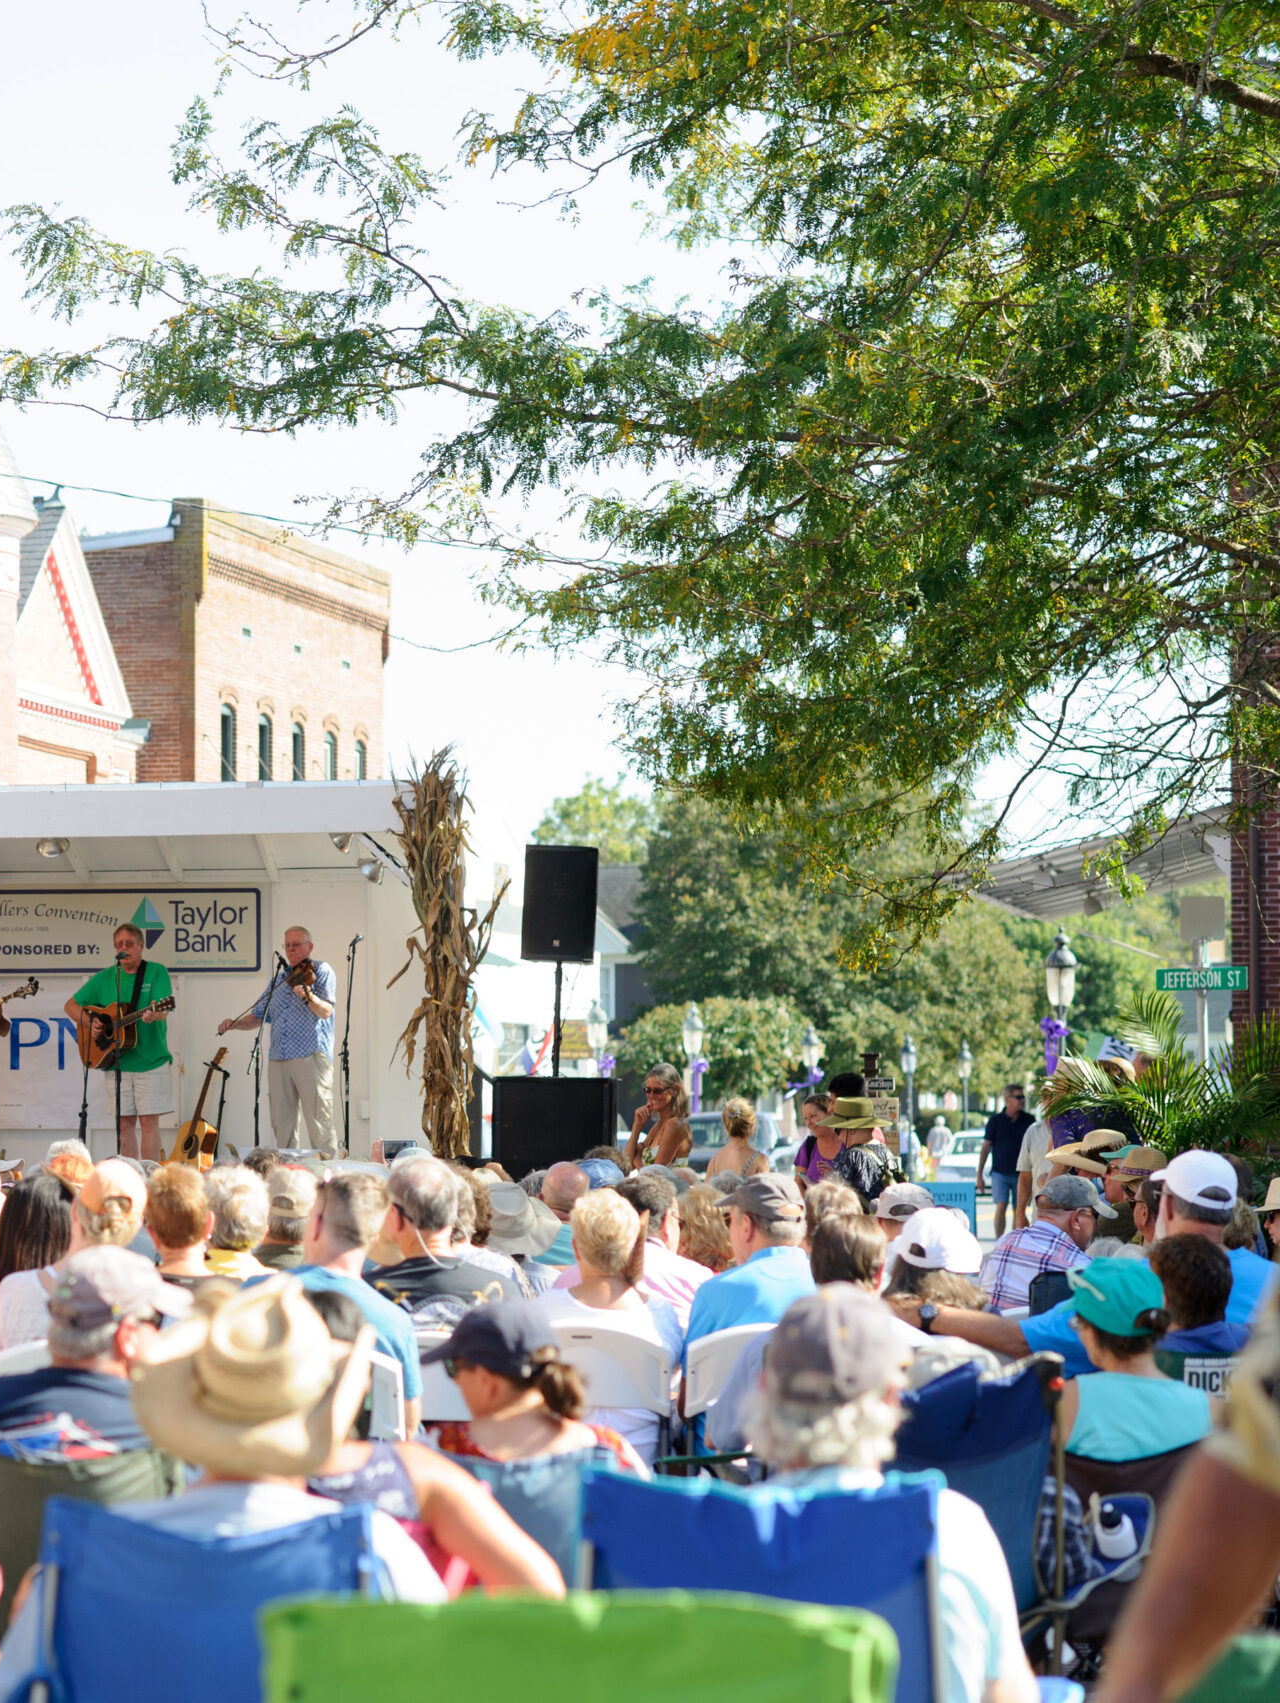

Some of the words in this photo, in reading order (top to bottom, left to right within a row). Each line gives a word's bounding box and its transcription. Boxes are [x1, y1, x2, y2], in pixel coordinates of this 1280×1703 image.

[34, 903, 119, 927] Convention
[168, 900, 249, 932] Taylor
[77, 944, 100, 955] BY:
[174, 927, 237, 953] Bank
[1163, 971, 1222, 989] JEFFERSON
[1227, 970, 1241, 987] ST
[10, 1017, 78, 1070] PN
[934, 1191, 967, 1202] ream
[1188, 1369, 1232, 1393] DICK
